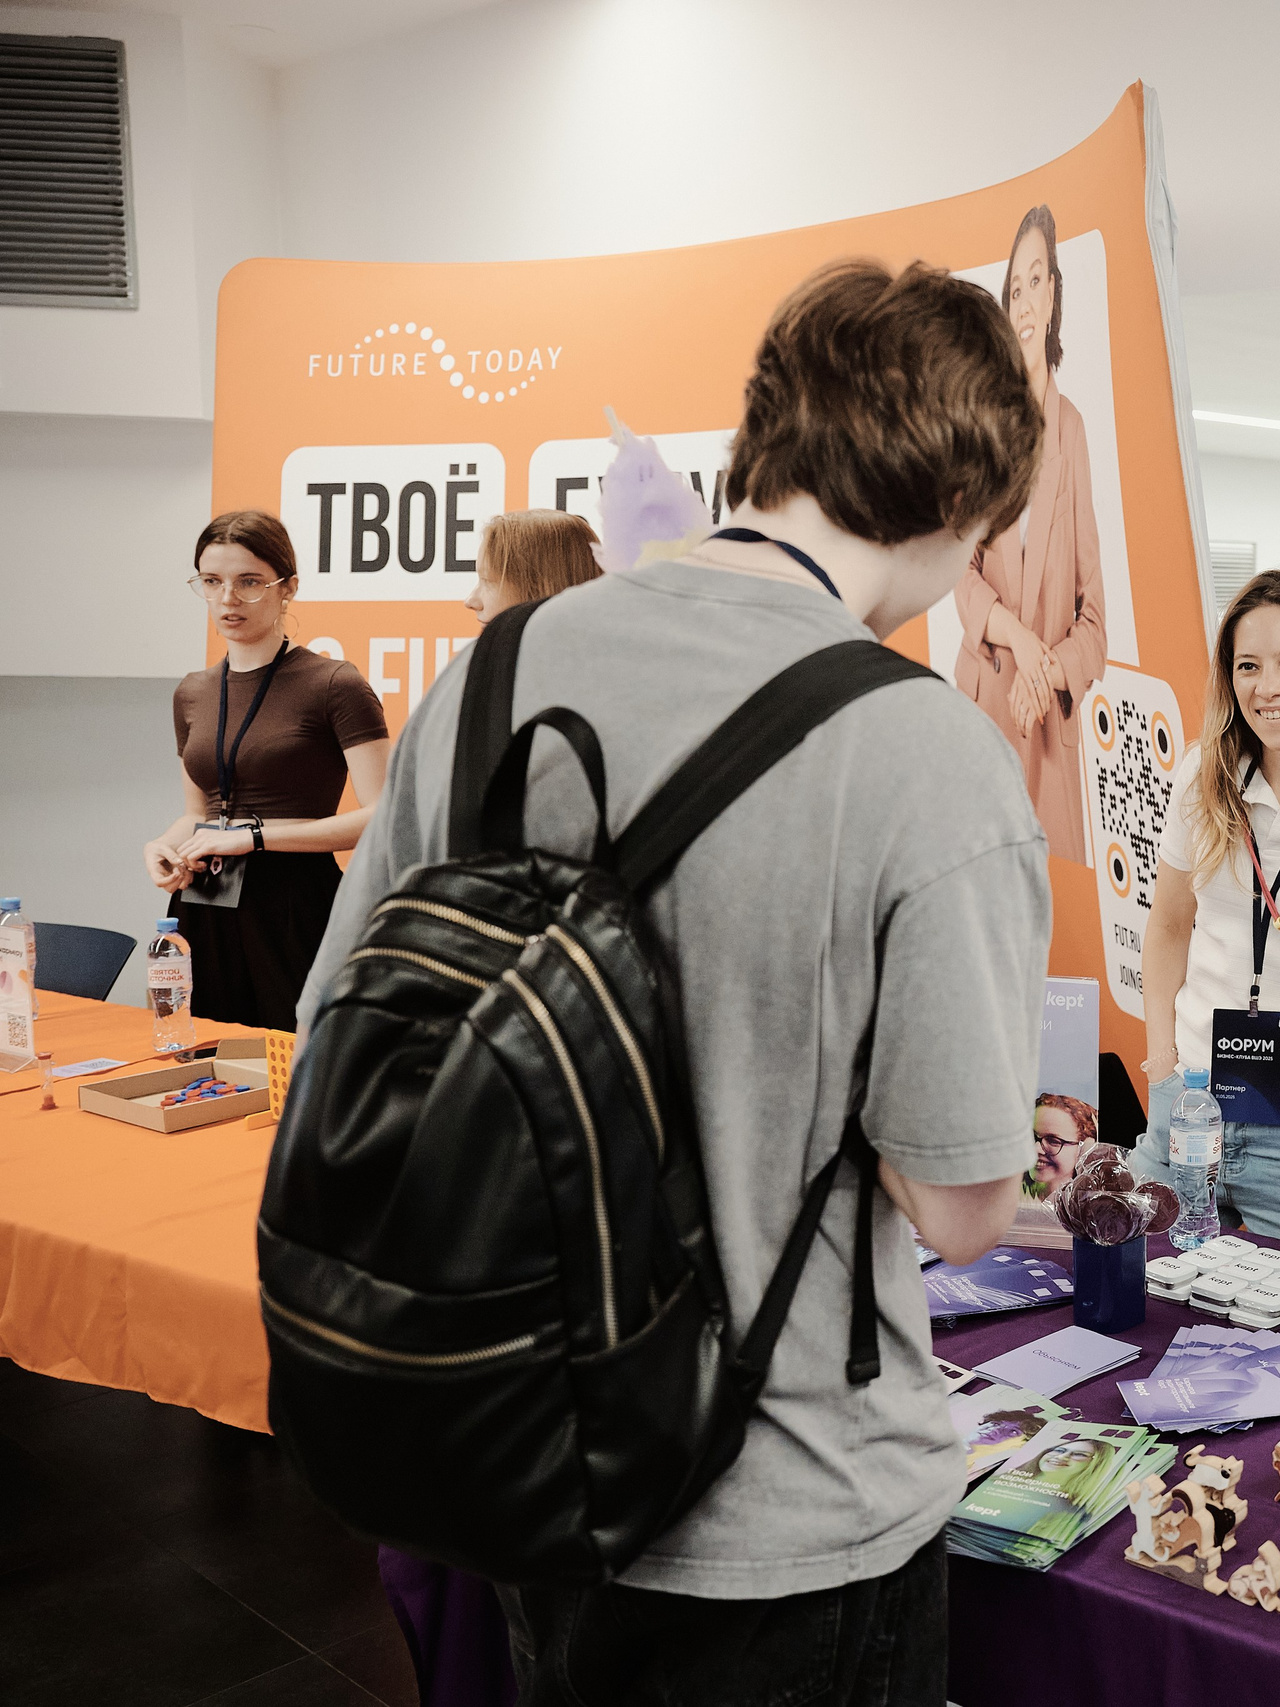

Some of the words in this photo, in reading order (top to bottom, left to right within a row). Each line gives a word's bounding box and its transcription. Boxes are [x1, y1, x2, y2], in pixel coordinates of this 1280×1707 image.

[308, 353, 427, 377] FUTURE
[468, 346, 562, 374] TODAY
[307, 463, 480, 574] ТВОЁ
[1115, 924, 1141, 953] FUT.RU
[1045, 991, 1085, 1010] kept
[1217, 1037, 1275, 1053] ФОРУМ
[1216, 1083, 1246, 1095] Партнер
[1219, 1239, 1242, 1248] kept
[1194, 1251, 1217, 1261] kept
[1158, 1260, 1181, 1270] kept
[1234, 1263, 1259, 1273] kept
[1208, 1276, 1233, 1286] kept
[1253, 1288, 1279, 1298] kept
[1133, 1381, 1150, 1396] kept
[1007, 1468, 1034, 1478] Твои
[1000, 1474, 1060, 1489] карьерные
[993, 1480, 1069, 1499] возможности
[965, 1502, 1001, 1517] kept
